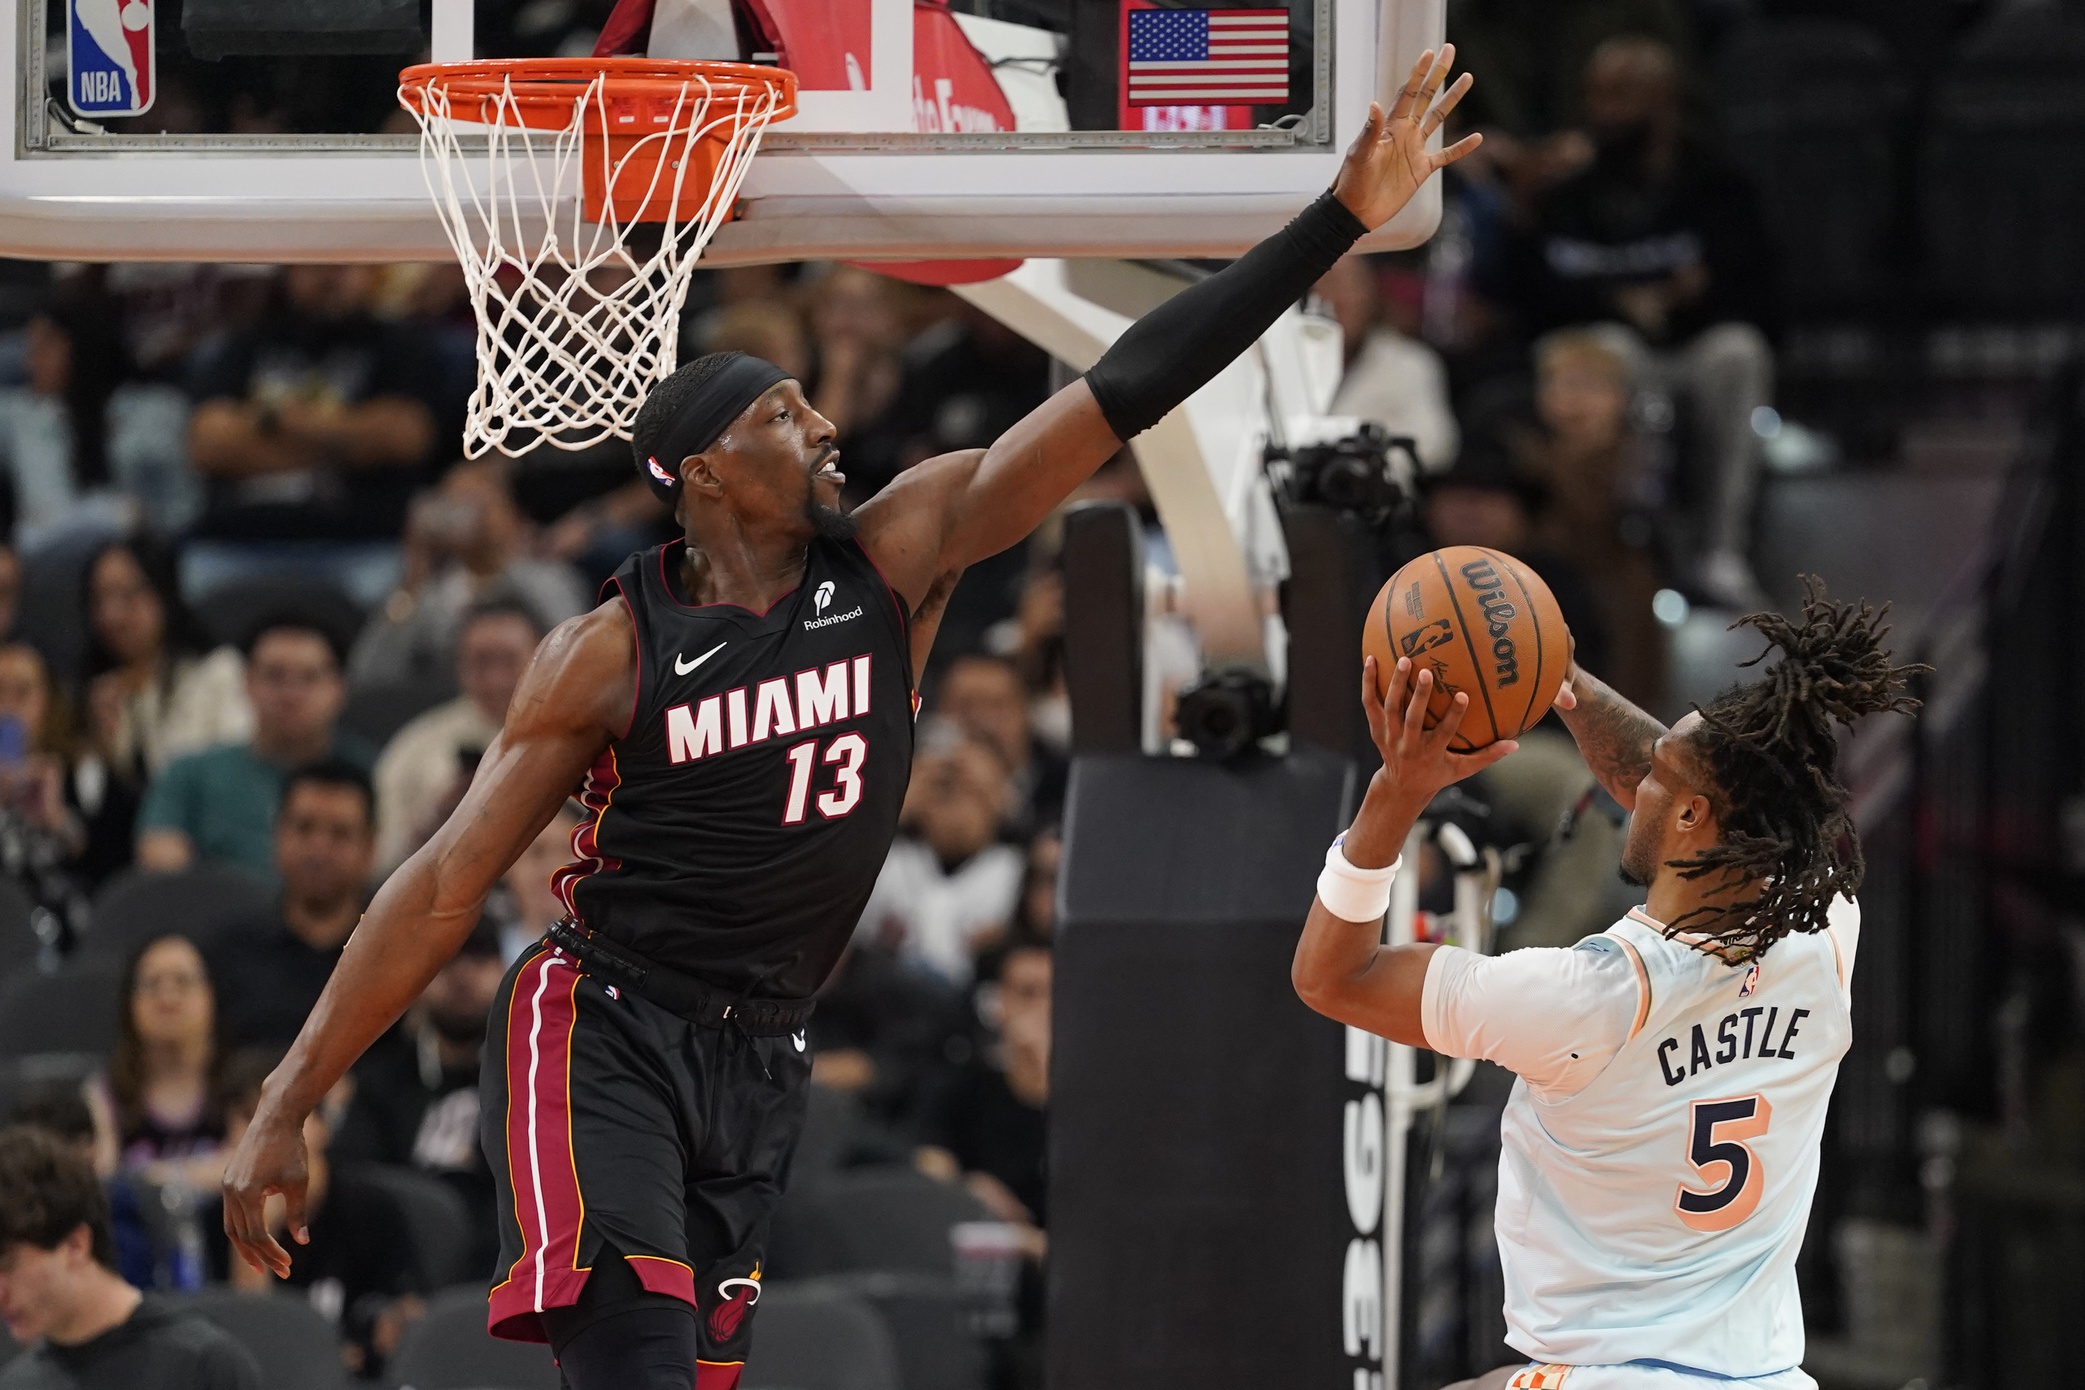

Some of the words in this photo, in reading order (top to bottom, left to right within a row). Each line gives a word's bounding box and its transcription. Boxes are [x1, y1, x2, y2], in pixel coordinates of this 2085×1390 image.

[81, 70, 122, 103] NBA
[803, 605, 864, 632] Robinhood
[1459, 557, 1520, 691] Wilson
[665, 653, 872, 766] MIAMI
[781, 731, 869, 826] 13
[1657, 1006, 1811, 1087] CASTLE
[1674, 1092, 1773, 1232] 5
